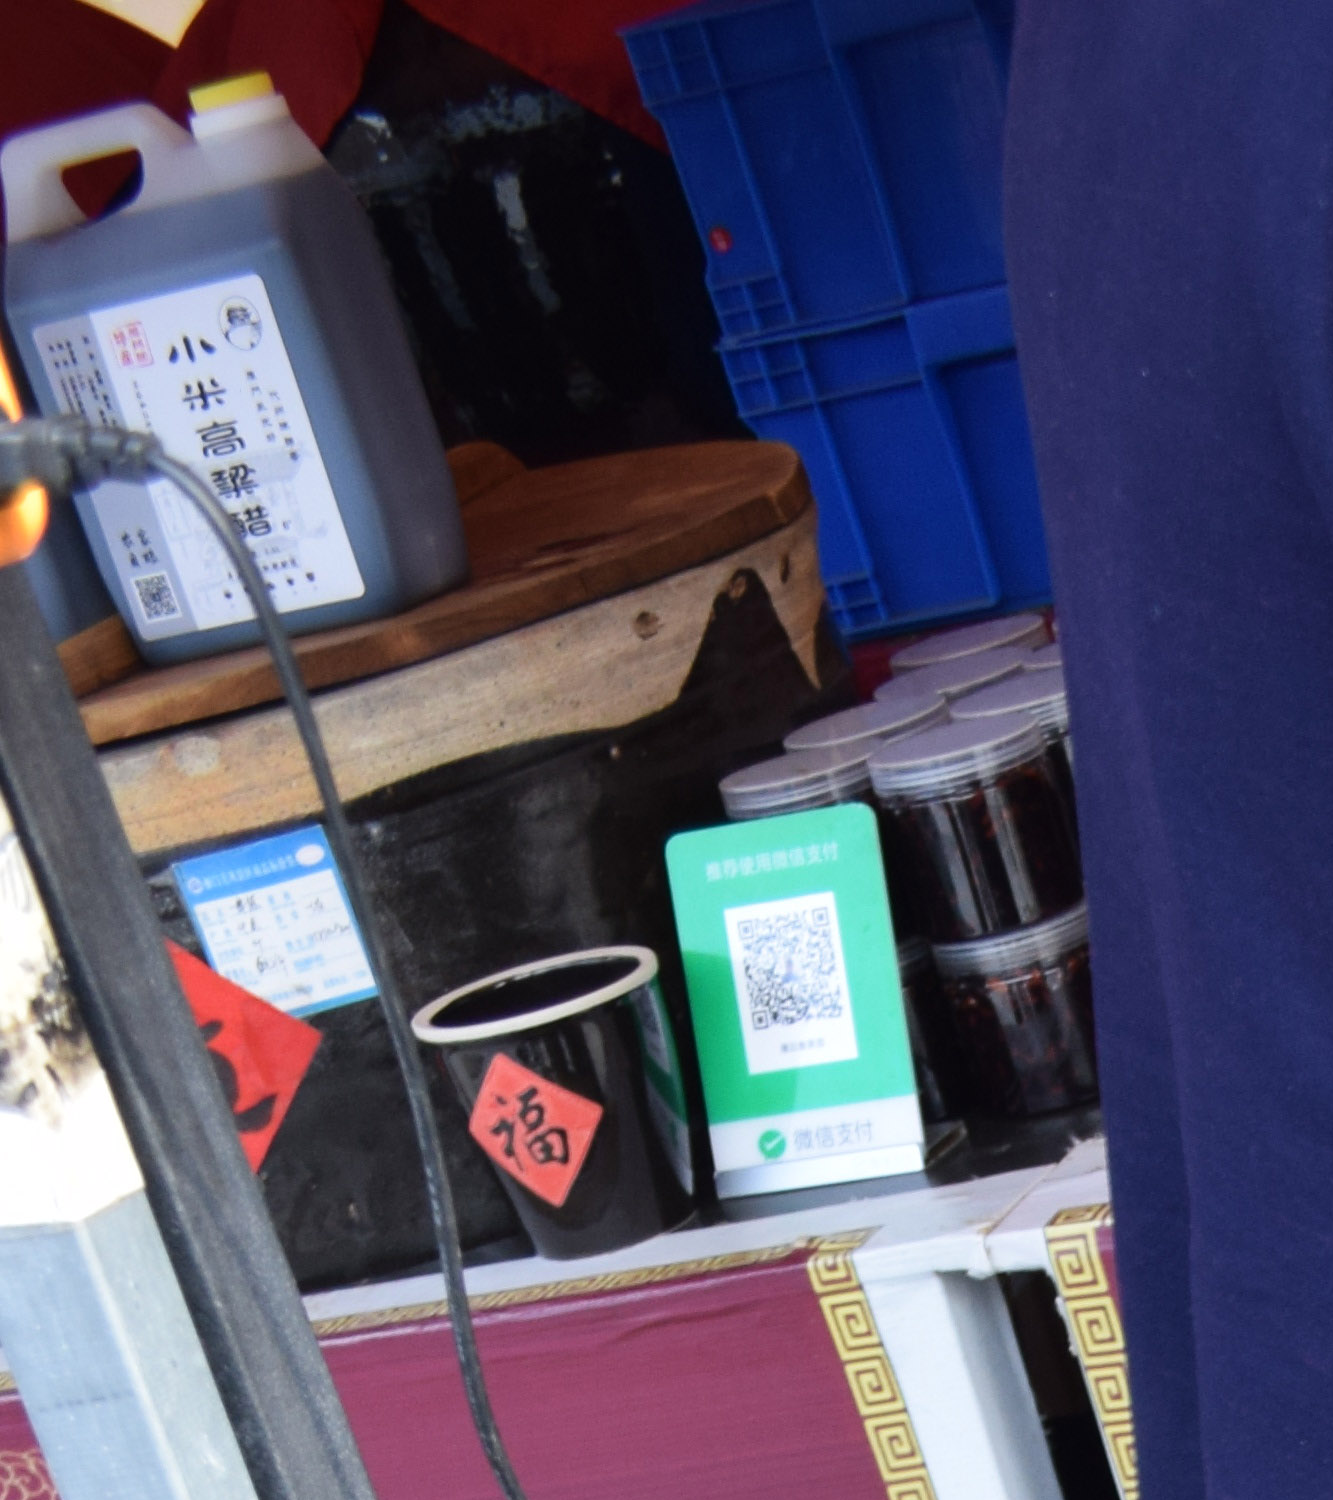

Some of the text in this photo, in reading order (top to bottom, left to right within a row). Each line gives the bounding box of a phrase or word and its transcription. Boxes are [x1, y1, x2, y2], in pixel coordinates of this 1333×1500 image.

[704, 841, 841, 883] 推荐使用微信支付
[490, 1085, 570, 1172] 福
[792, 1118, 875, 1152] 微信支付
